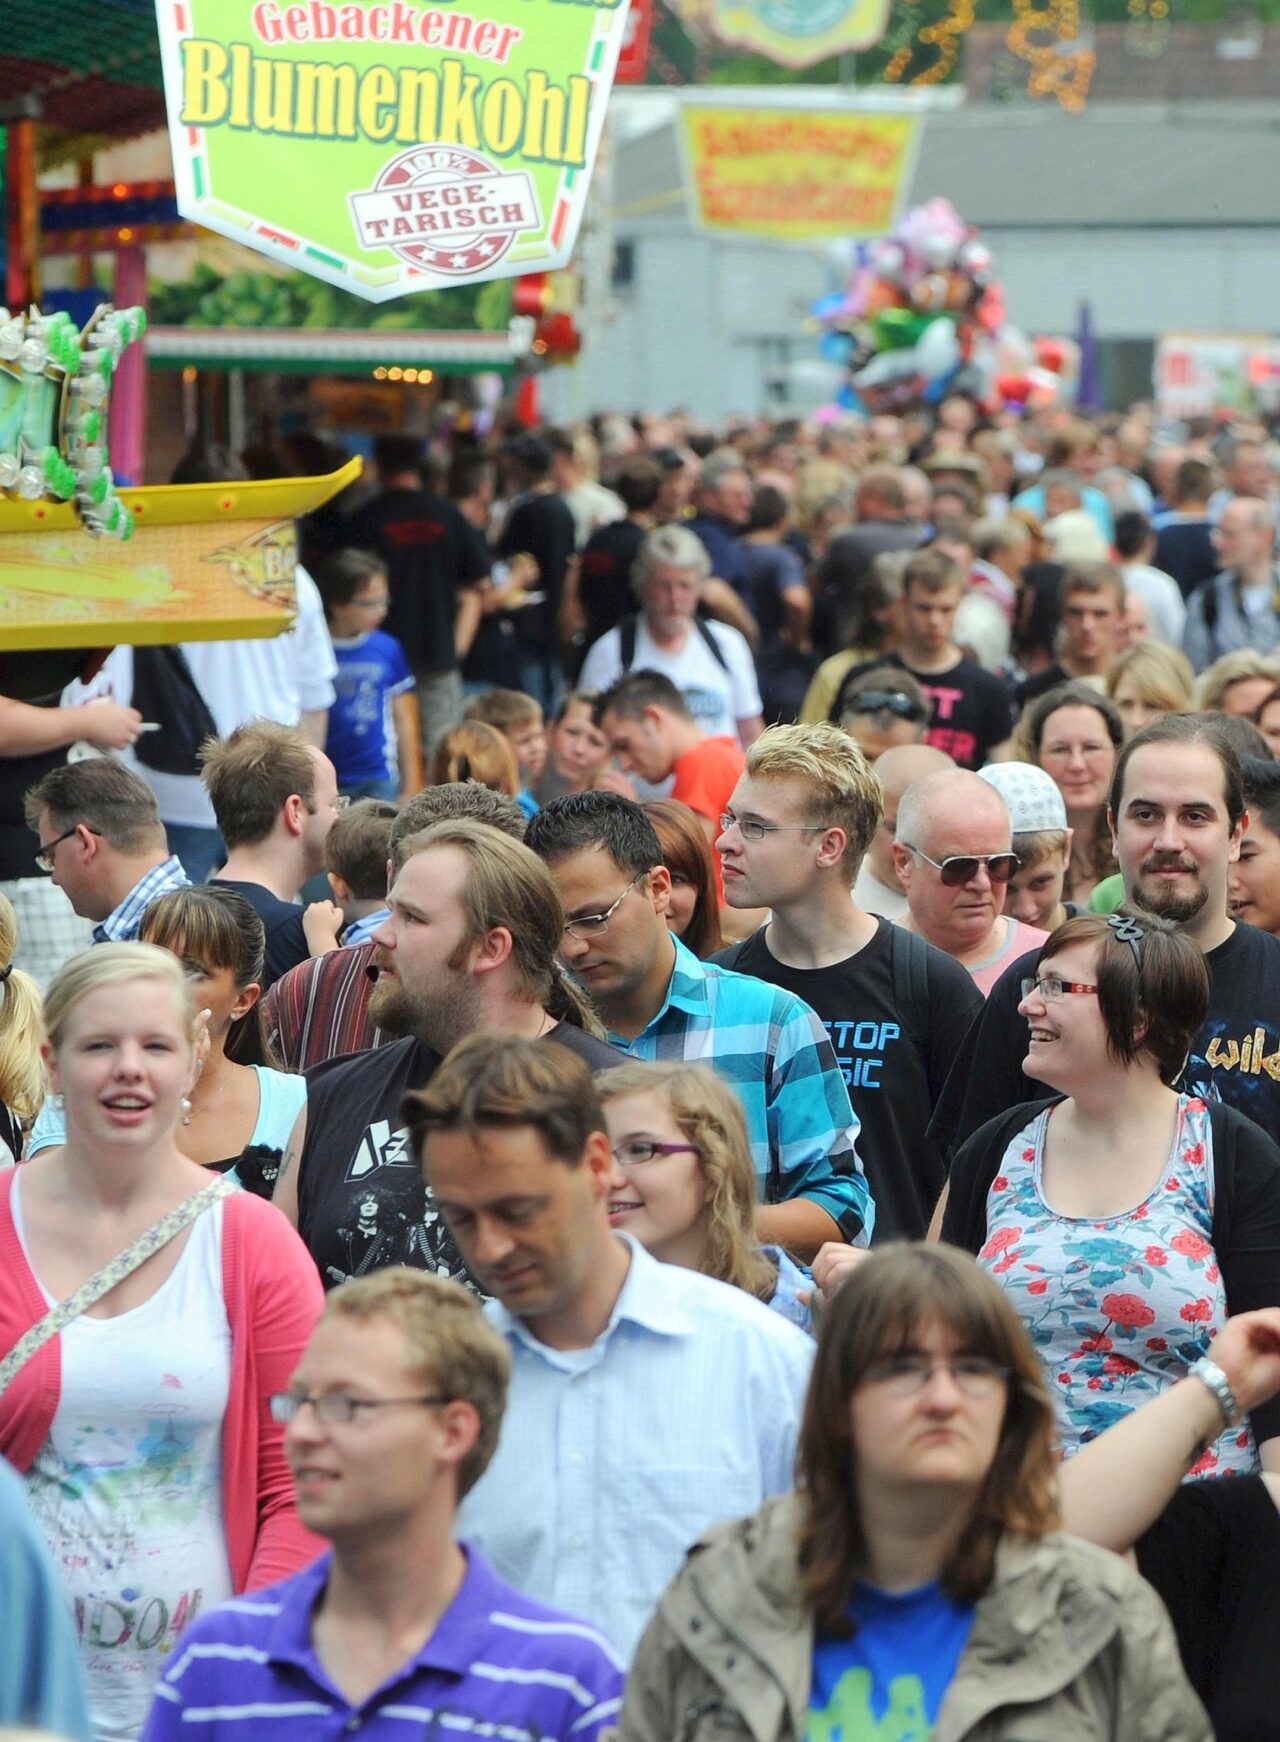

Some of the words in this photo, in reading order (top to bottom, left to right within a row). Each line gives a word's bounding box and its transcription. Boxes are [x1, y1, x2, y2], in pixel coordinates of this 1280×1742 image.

[252, 0, 522, 63] Gebackener
[181, 40, 590, 168] Blumenkohl
[400, 151, 470, 174] 100%
[392, 184, 496, 213] VEGE-
[365, 203, 525, 239] TARISCH
